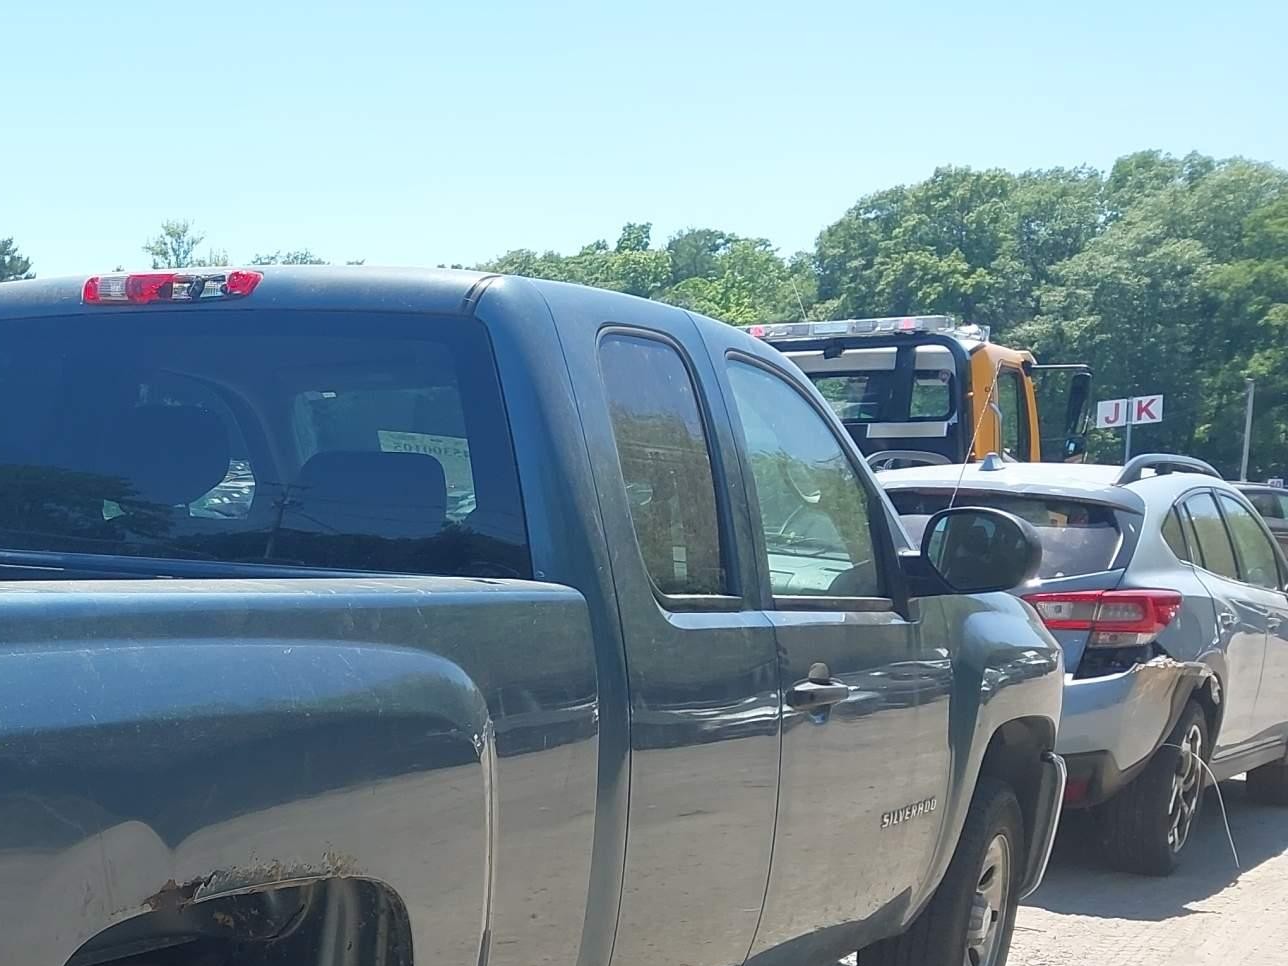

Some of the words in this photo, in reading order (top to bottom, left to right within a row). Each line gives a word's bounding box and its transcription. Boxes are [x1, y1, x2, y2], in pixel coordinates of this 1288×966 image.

[1104, 402, 1120, 425] J
[1136, 398, 1158, 421] K
[880, 799, 937, 829] SILVERADO
